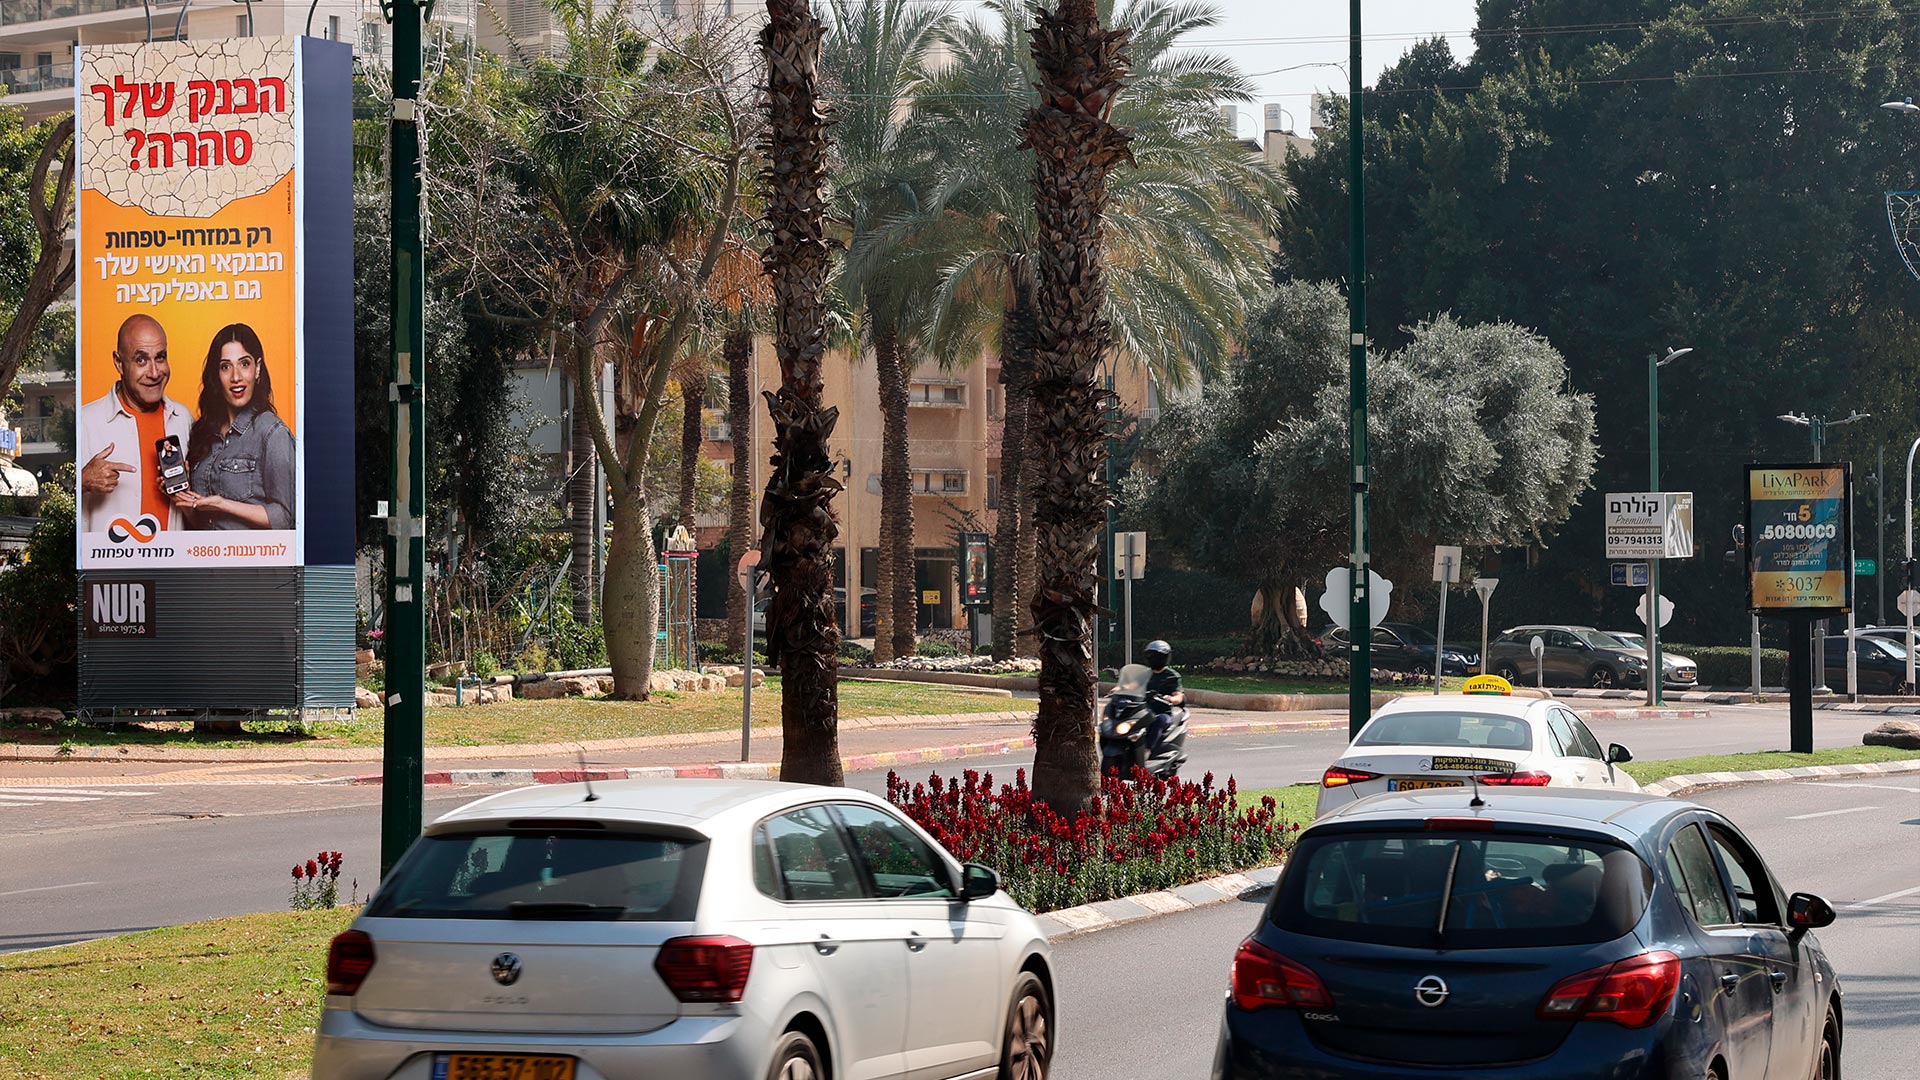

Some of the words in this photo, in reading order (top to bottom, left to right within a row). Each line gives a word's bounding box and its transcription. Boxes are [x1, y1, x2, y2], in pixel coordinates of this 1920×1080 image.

[90, 75, 175, 126] שלך
[188, 76, 285, 123] הבנק
[125, 129, 253, 171] סהרה?
[105, 228, 241, 249] במזרחי-טפחות
[246, 227, 272, 248] רק
[94, 252, 139, 280] שלך
[145, 254, 205, 274] האישי
[211, 251, 283, 276] הבנקאי
[116, 278, 228, 306] באפליקציה
[234, 280, 261, 300] גם
[1798, 504, 1811, 521] 5
[223, 543, 287, 557] להתרעננות:
[1608, 536, 1663, 545] 09-7941313
[90, 547, 133, 559] טפחות
[138, 547, 174, 558] מזרחי
[93, 583, 146, 623] NUR
[99, 624, 119, 633] since
[120, 625, 138, 634] 1975
[1485, 683, 1506, 692] מונית
[1304, 1012, 1340, 1022] CORSA
